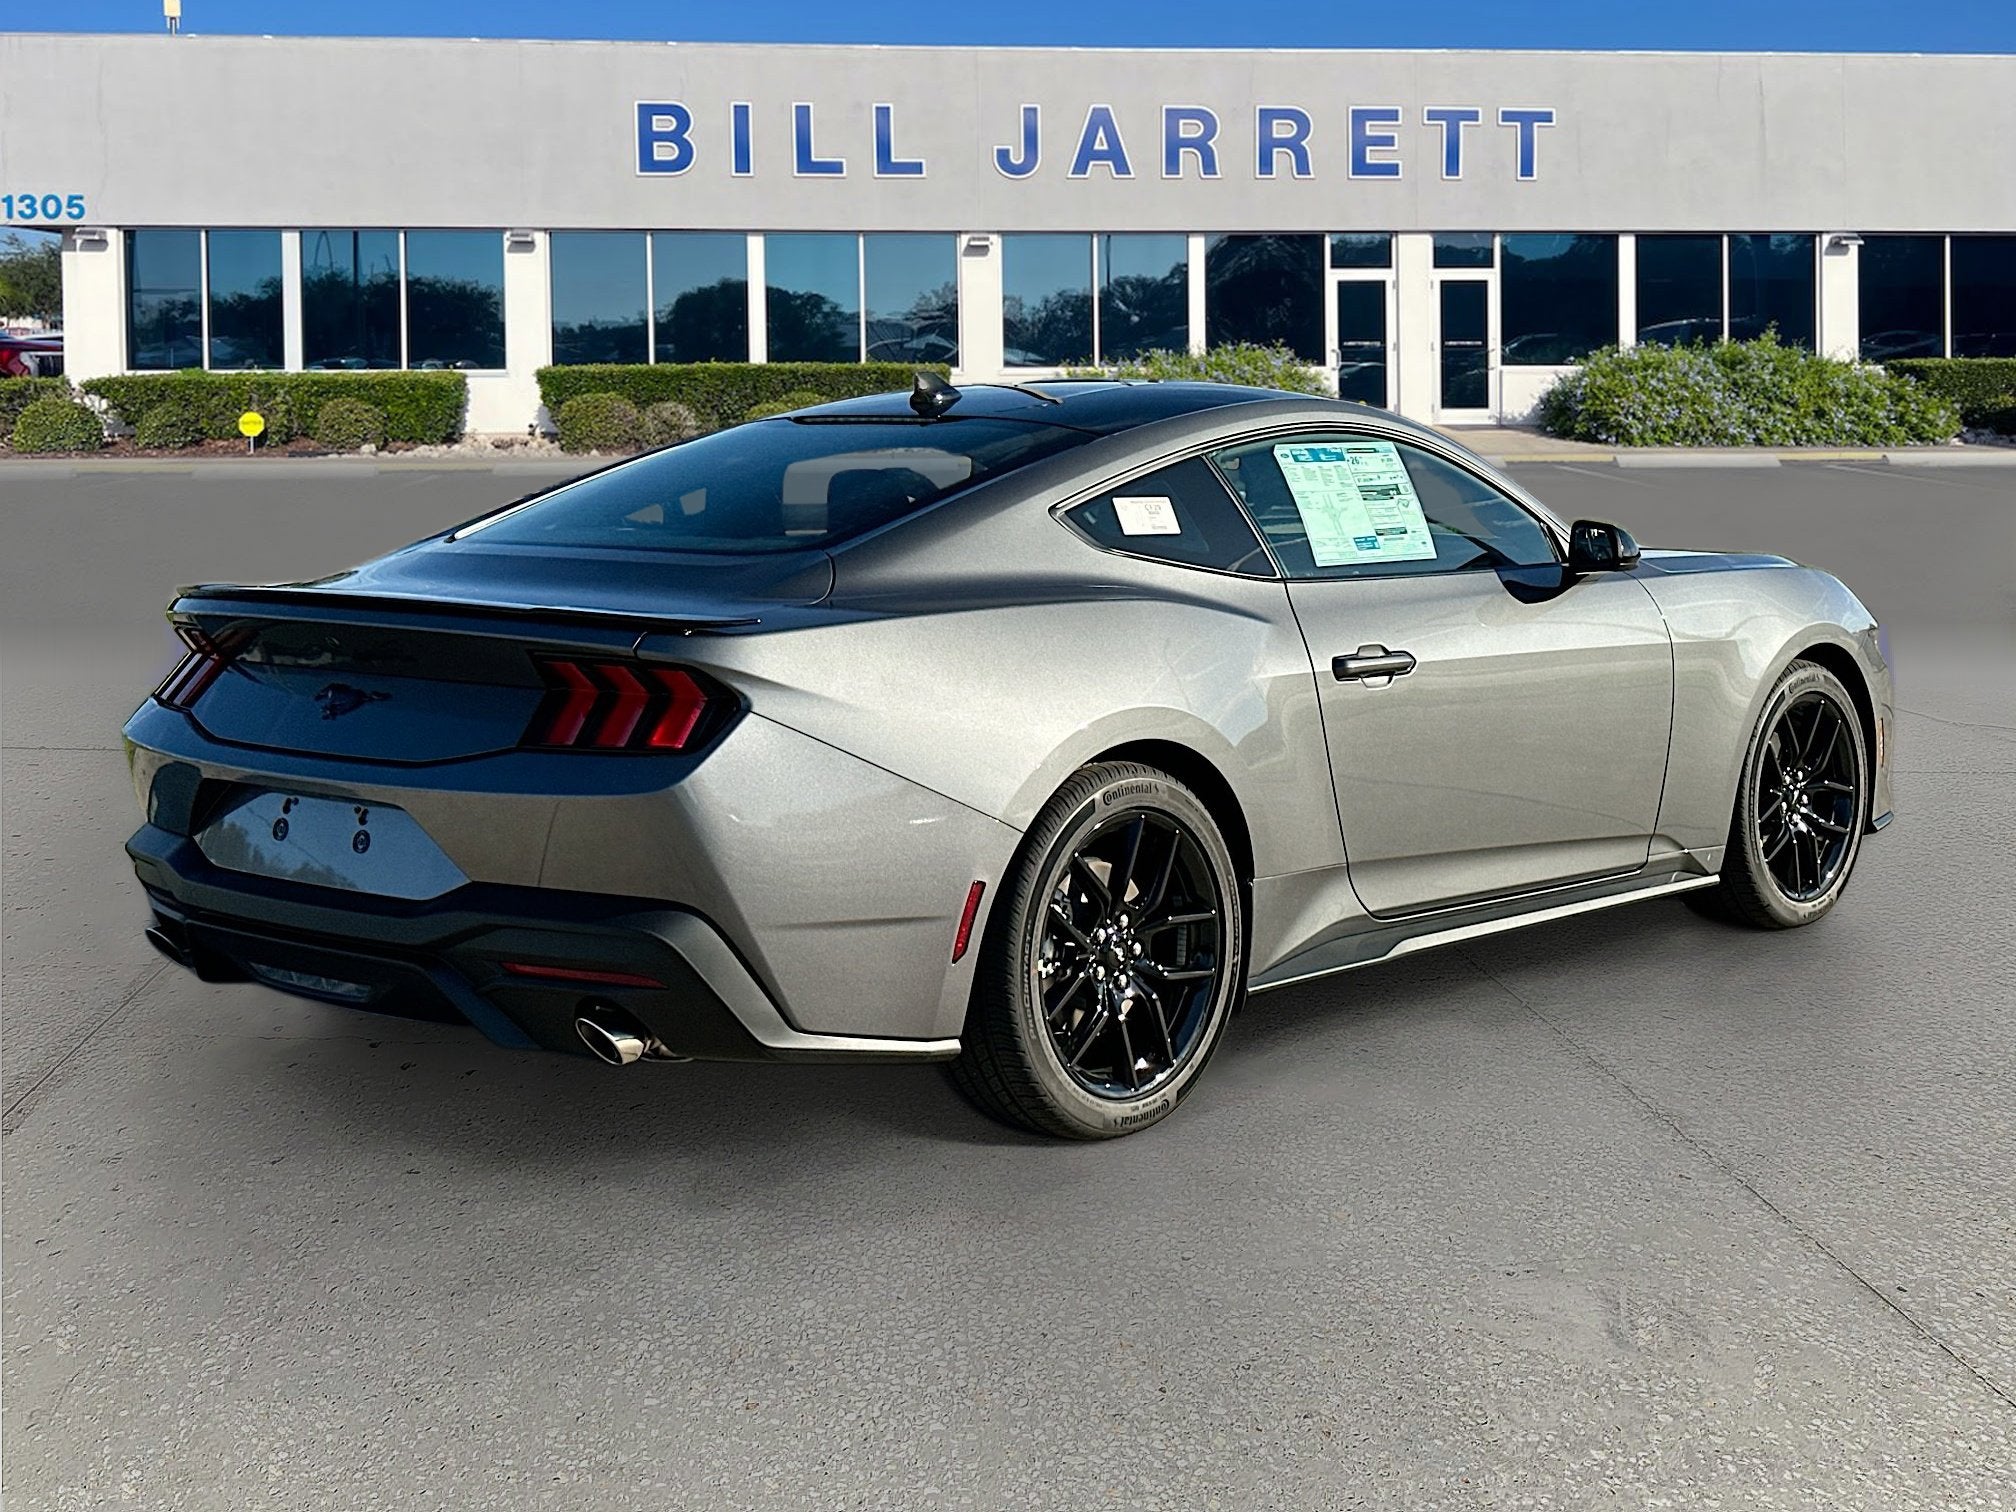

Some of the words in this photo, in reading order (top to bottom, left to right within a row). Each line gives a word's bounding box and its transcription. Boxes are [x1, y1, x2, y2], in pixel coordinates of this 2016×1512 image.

[634, 100, 926, 179] BILL
[992, 103, 1557, 182] JARRETT
[1, 193, 86, 220] 1305
[1102, 782, 1152, 806] Continental
